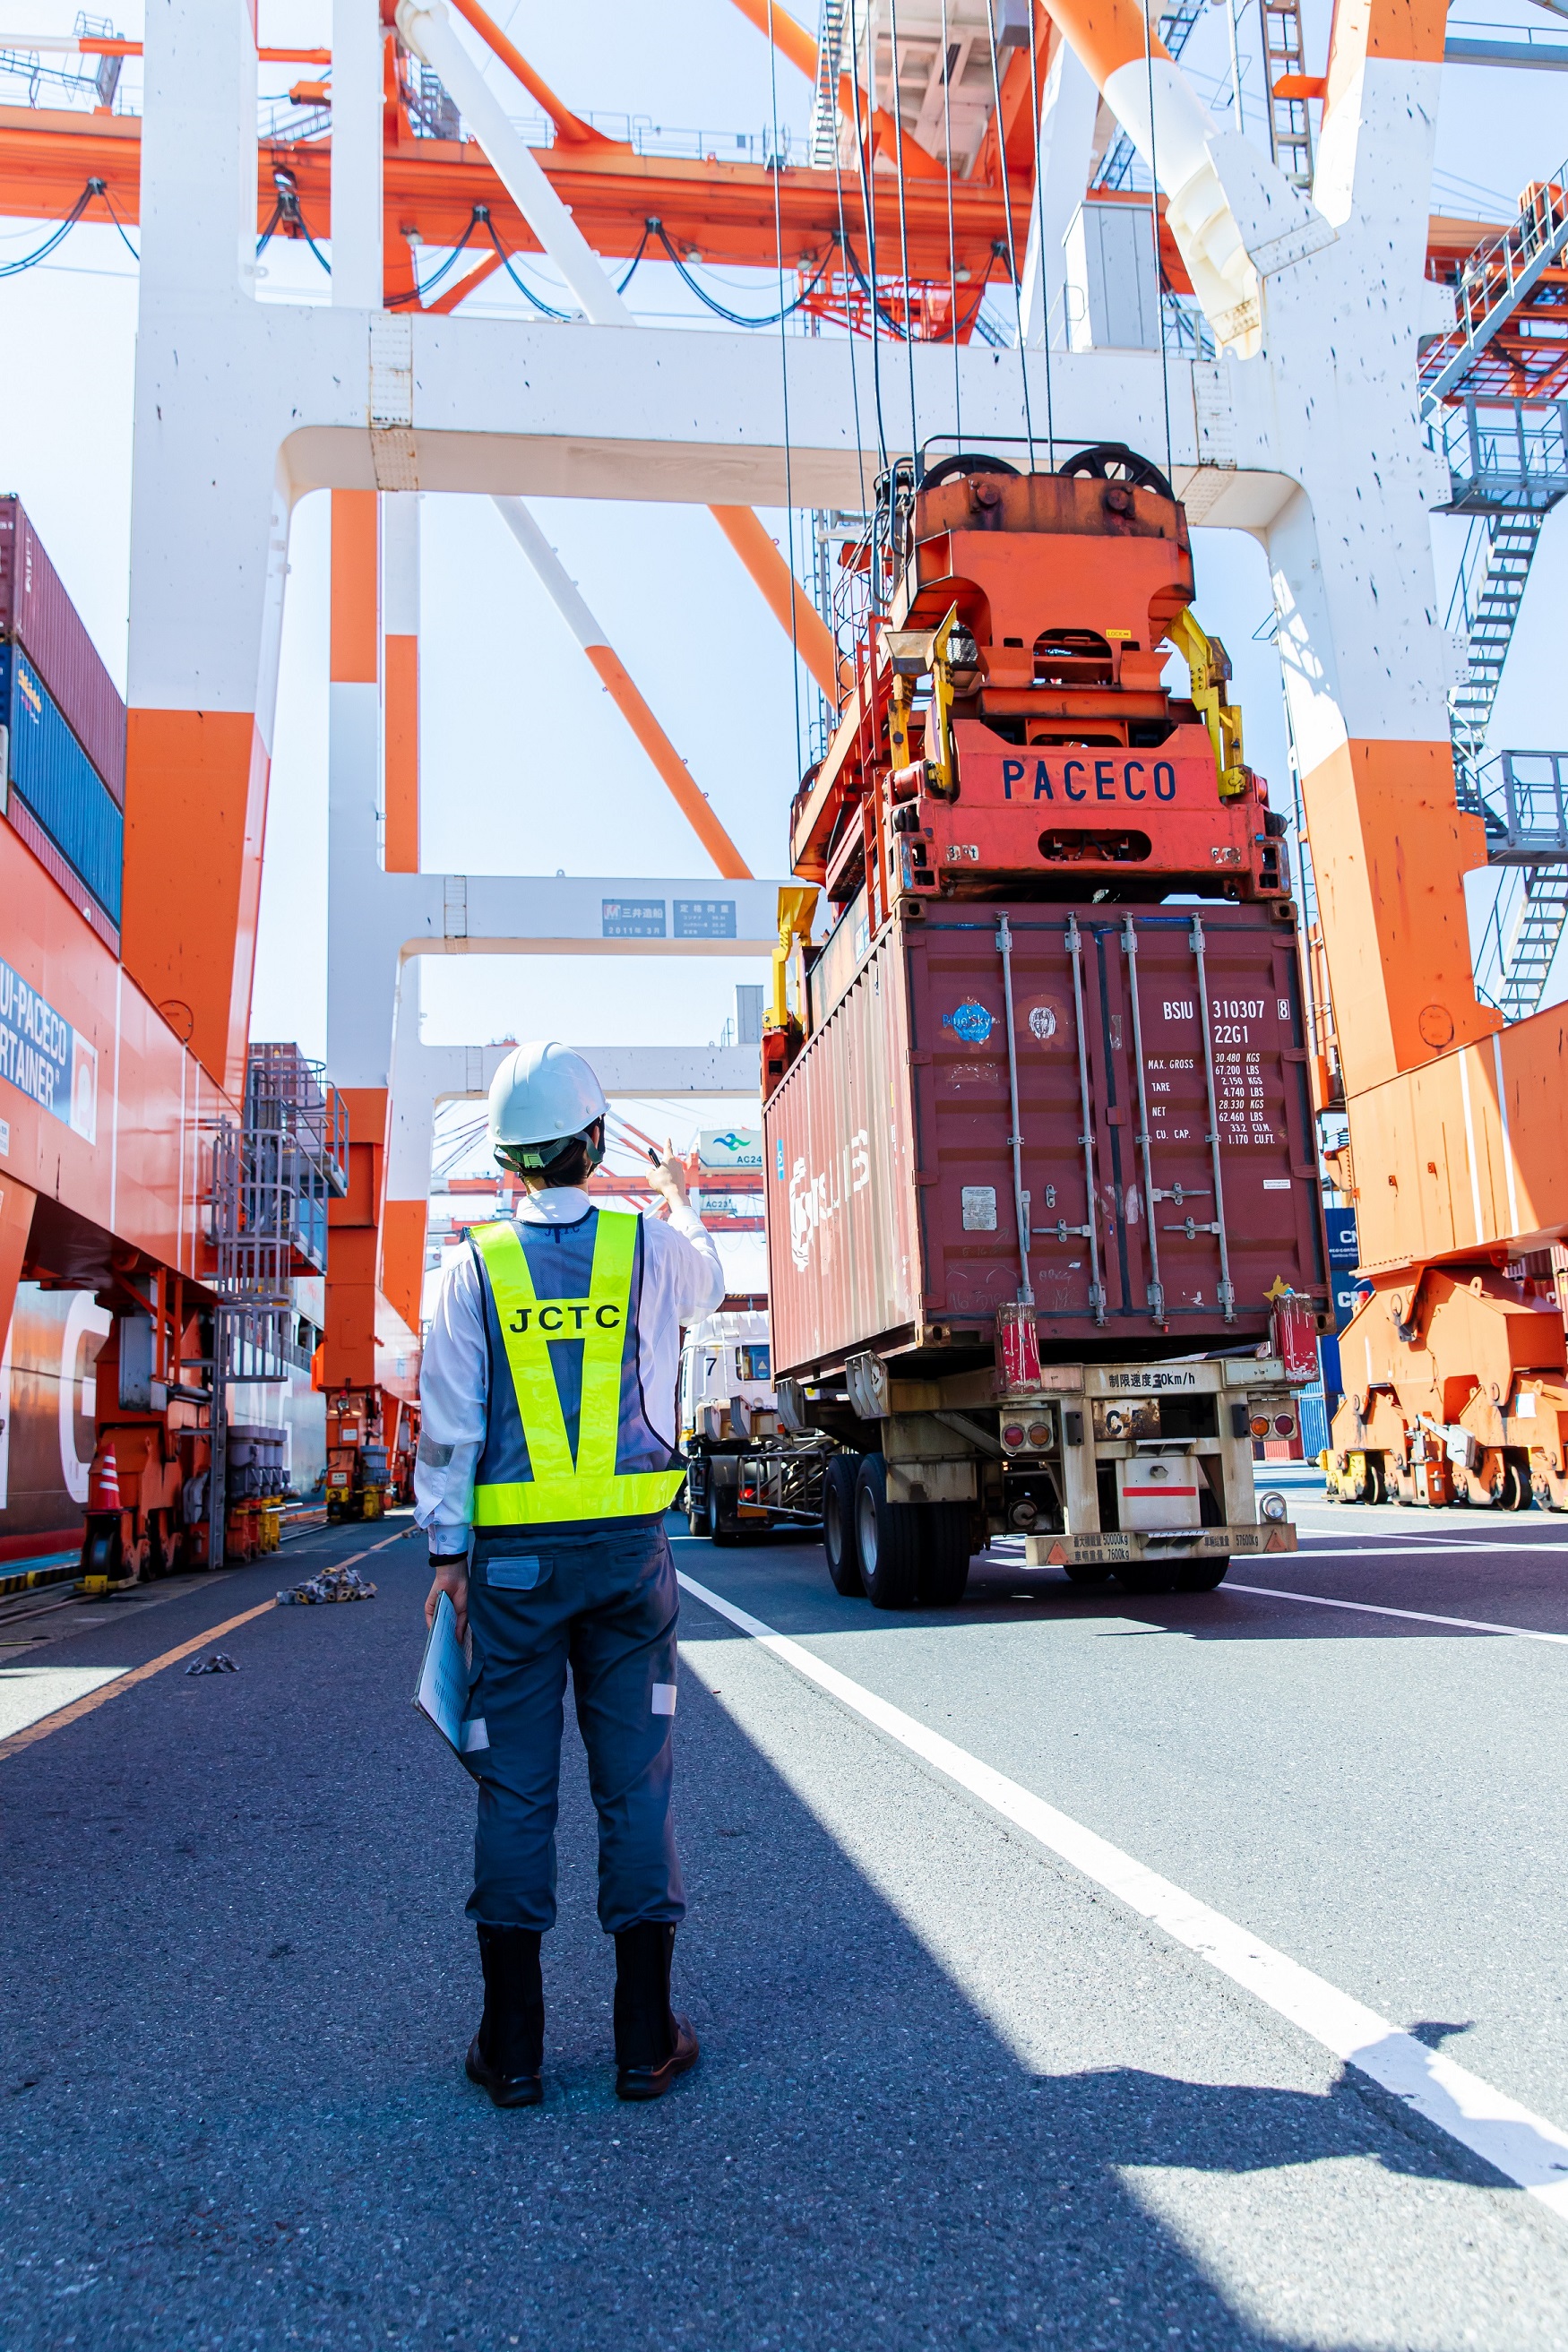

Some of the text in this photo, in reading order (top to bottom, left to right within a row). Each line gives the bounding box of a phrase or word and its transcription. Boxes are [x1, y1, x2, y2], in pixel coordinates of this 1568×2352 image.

[1003, 760, 1176, 801] PACECO
[1163, 1000, 1289, 1020] BSIU 310307 8
[1214, 1025, 1248, 1043] 22G1
[1215, 1053, 1260, 1063] 30.480 KGS
[1148, 1059, 1193, 1070] MAX. GROSS
[1215, 1065, 1259, 1074] 67.200 LBS
[1220, 1077, 1243, 1085] 2.150
[1151, 1082, 1170, 1091] TARE
[1223, 1087, 1263, 1097] 4.740 LBS
[1219, 1099, 1264, 1109] 28.330 KGS
[1152, 1107, 1166, 1116] NET
[1219, 1112, 1263, 1122] 62.460 LBS
[1230, 1124, 1247, 1132] 33.2
[1156, 1129, 1191, 1139] CU. CAP.
[1228, 1134, 1248, 1144] 1.170
[510, 1305, 620, 1333] JCTC
[705, 1357, 717, 1376] 7
[1103, 1533, 1128, 1546] 50000kg
[1108, 1548, 1129, 1560] 7600kg
